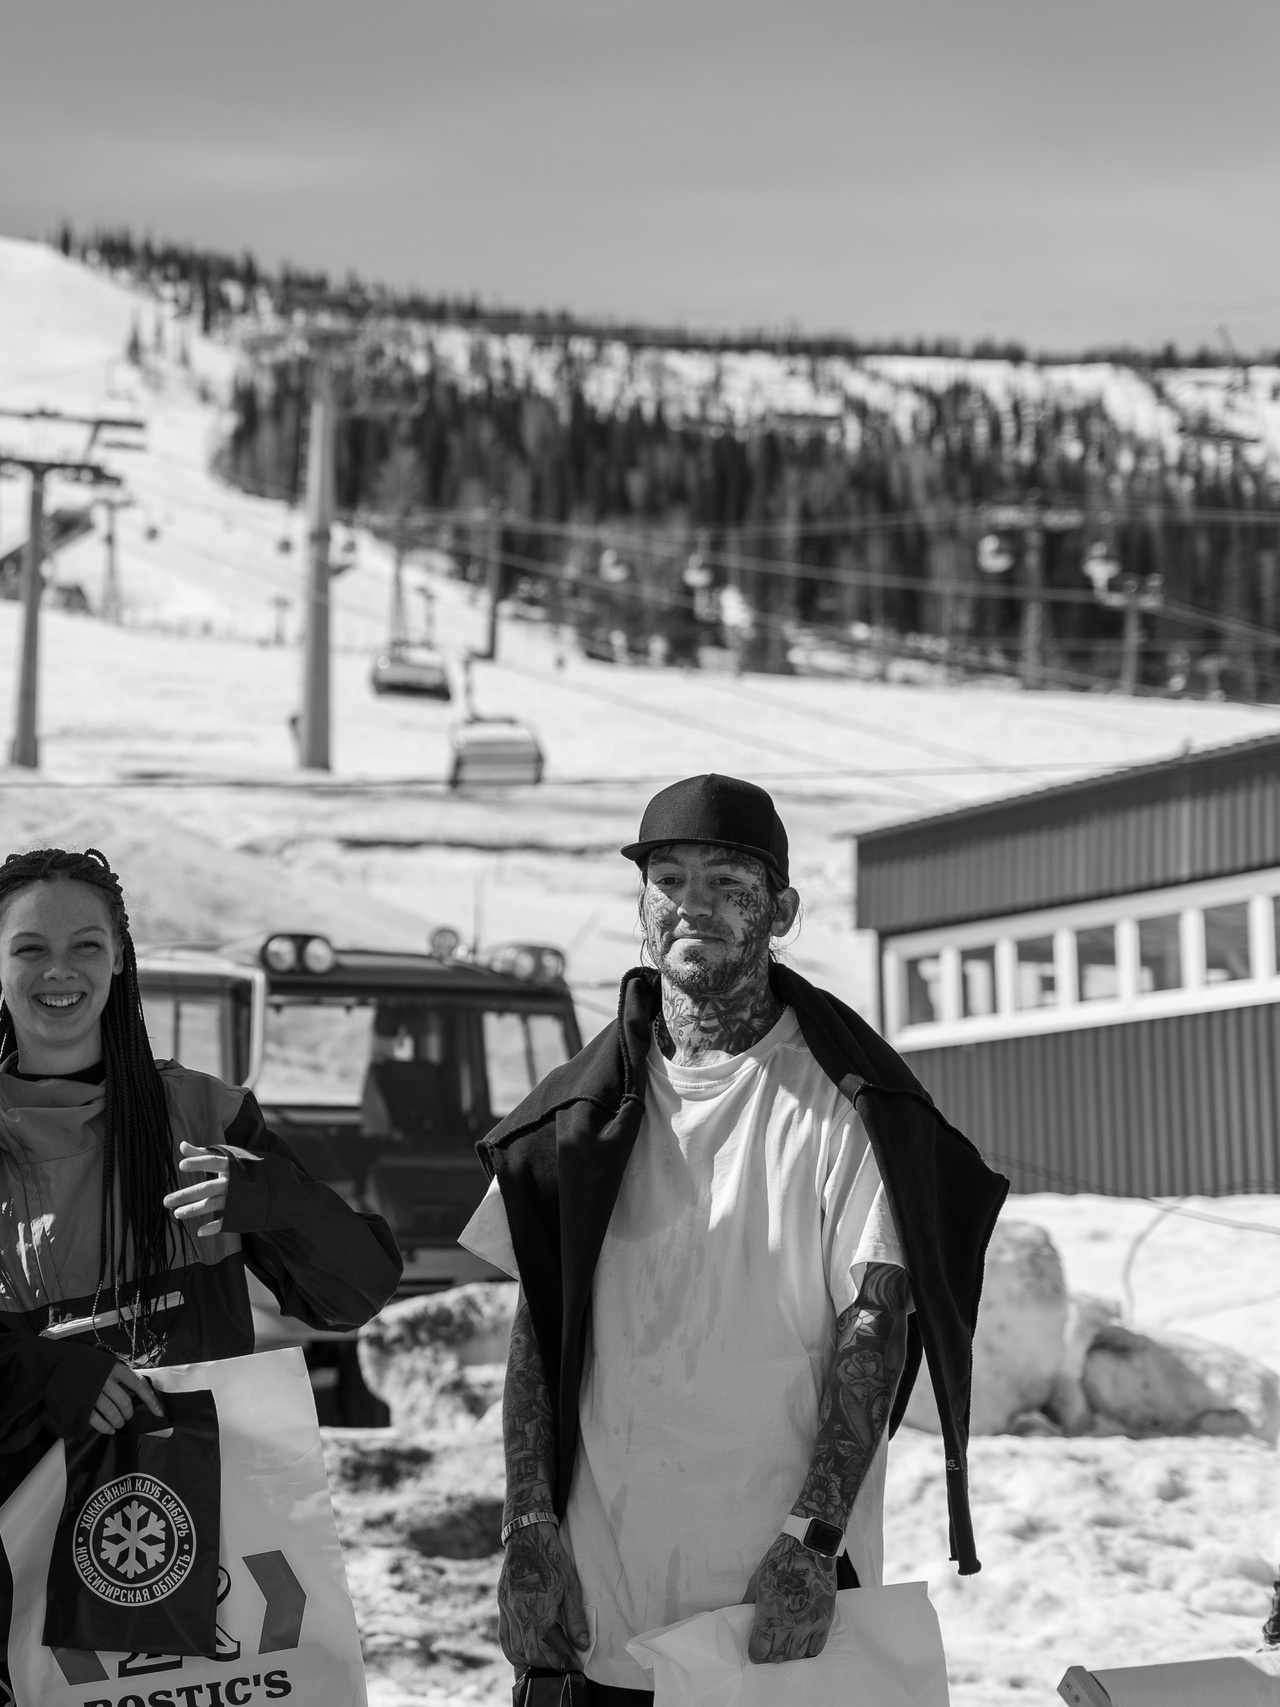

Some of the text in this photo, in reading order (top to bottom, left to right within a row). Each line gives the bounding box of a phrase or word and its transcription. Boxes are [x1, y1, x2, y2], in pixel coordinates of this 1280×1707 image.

[80, 1477, 190, 1537] ХОККЕЙНЫЙ КЛУБ СИБИРЬ
[76, 1546, 191, 1602] НОВОСИБИРСКАЯ ОБЛАСТЬ
[83, 1669, 292, 1707] STIC'S
